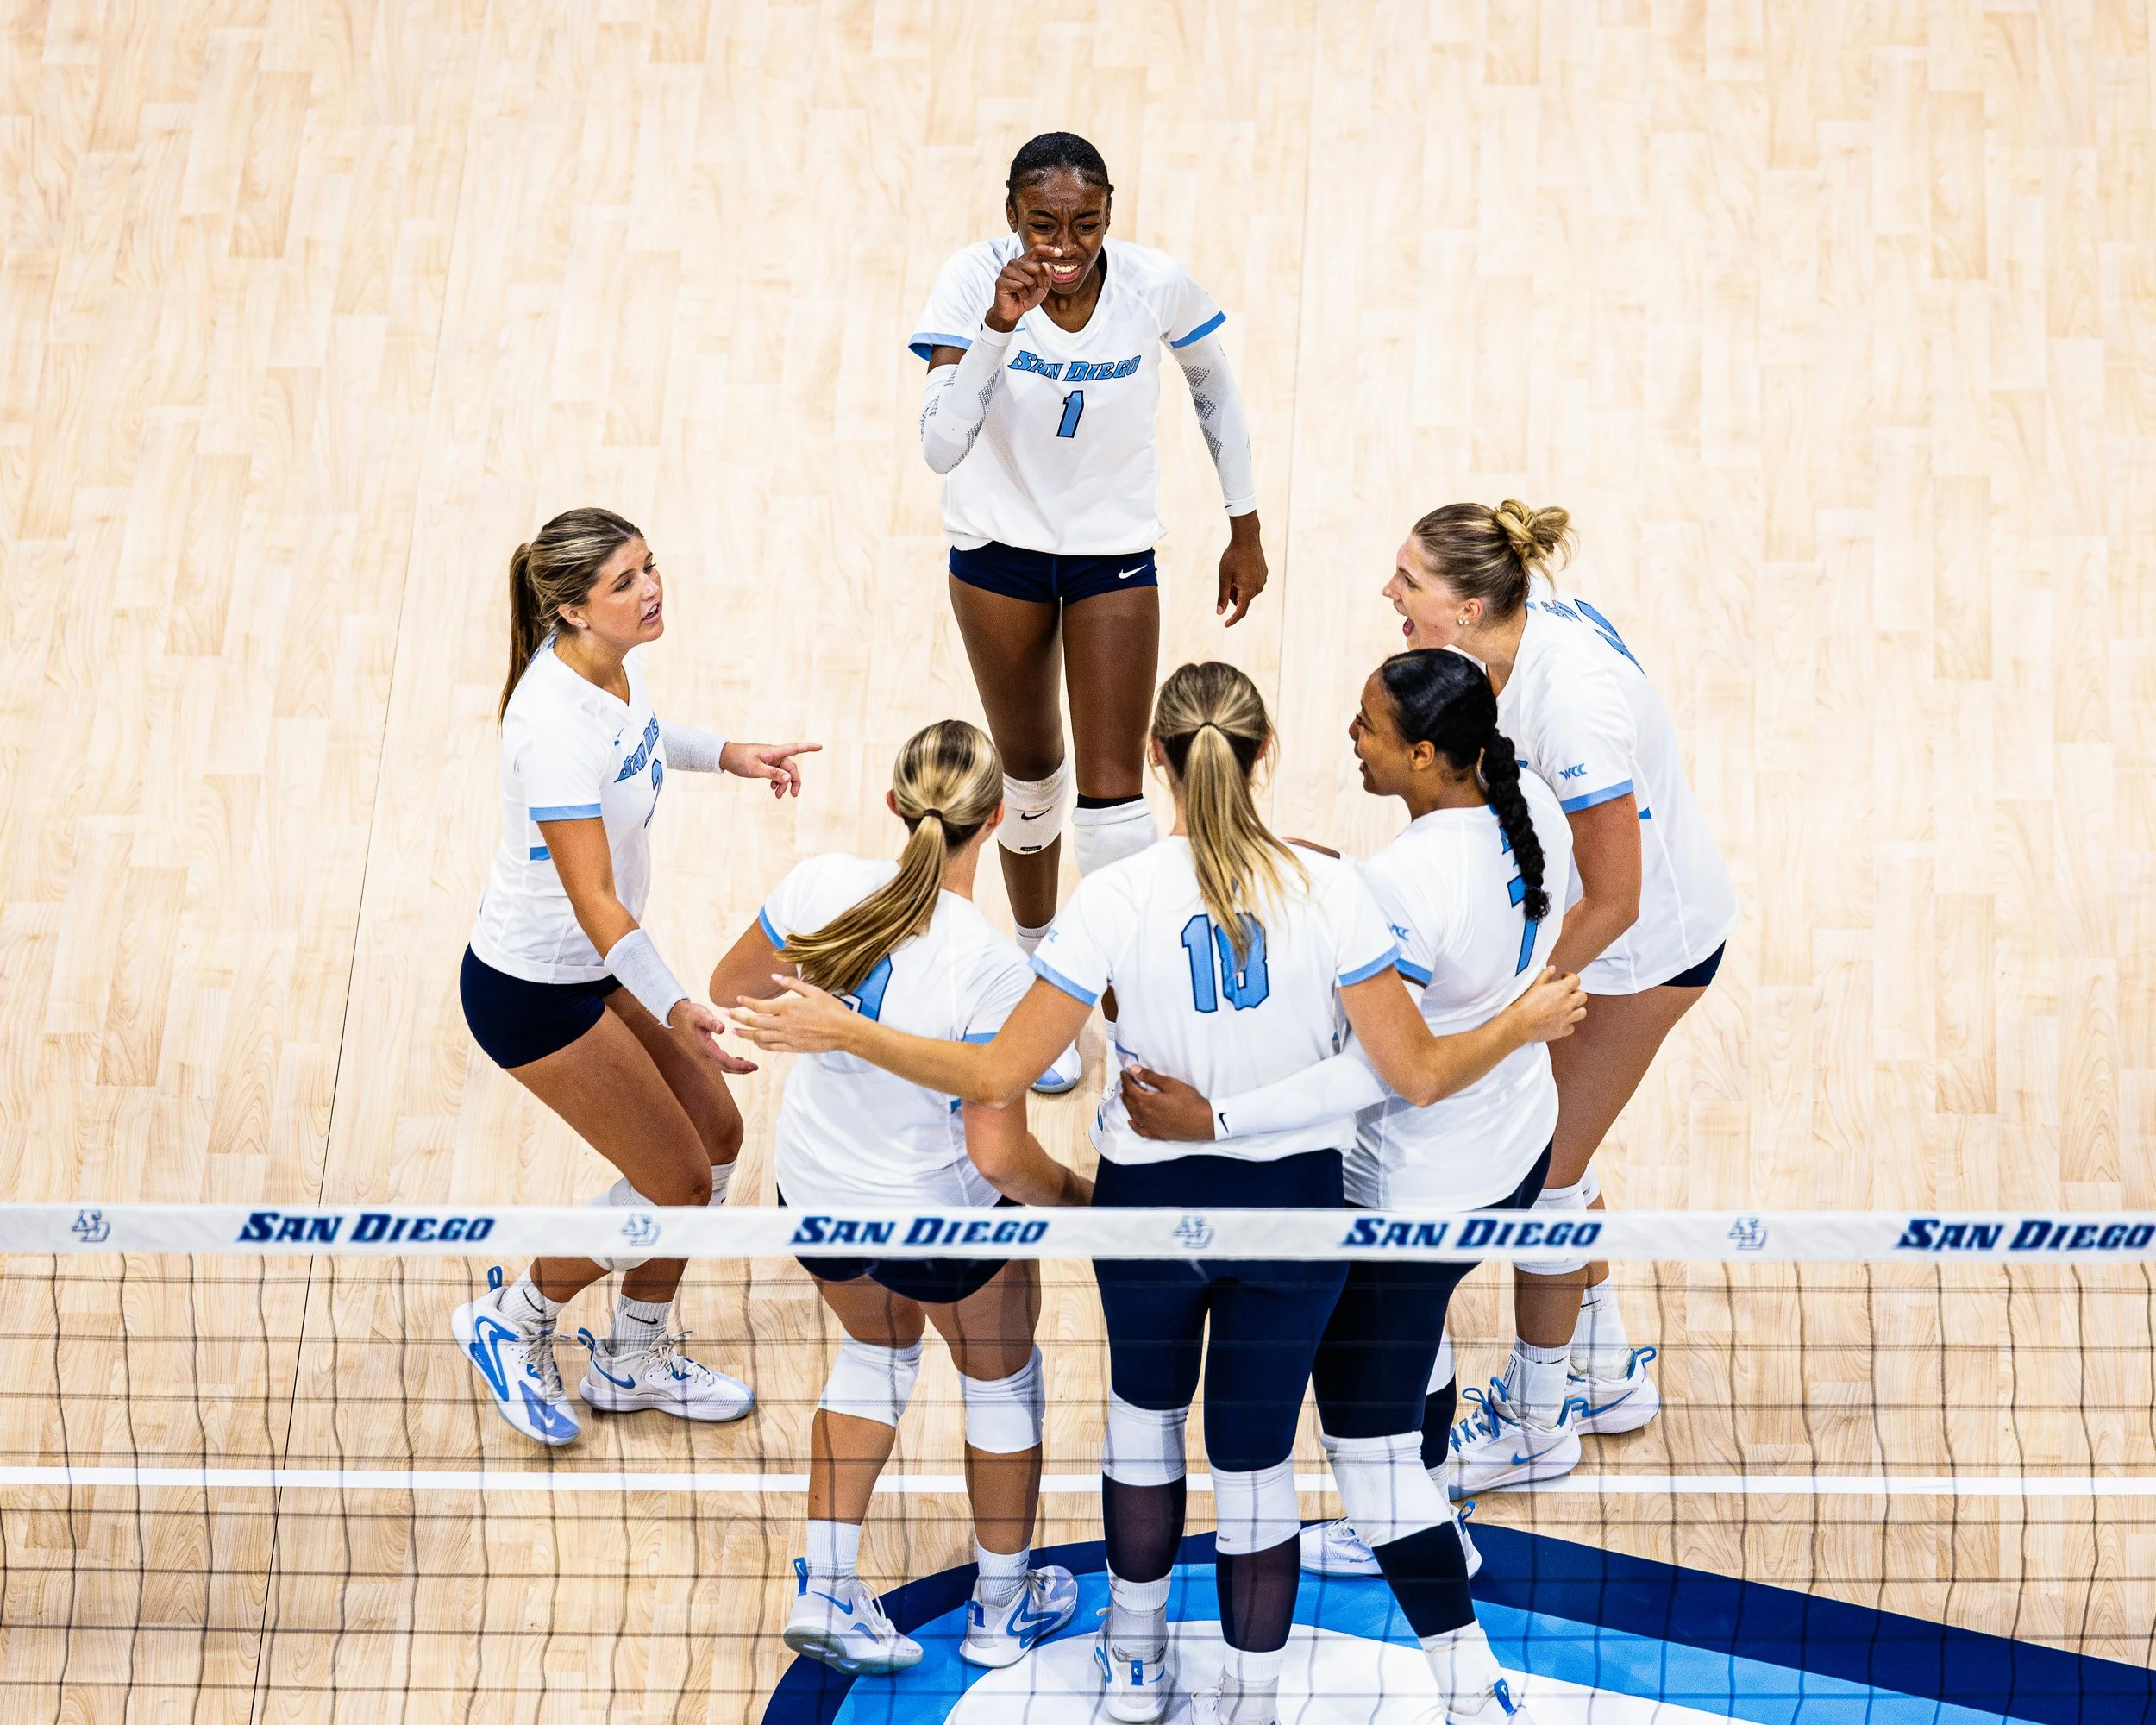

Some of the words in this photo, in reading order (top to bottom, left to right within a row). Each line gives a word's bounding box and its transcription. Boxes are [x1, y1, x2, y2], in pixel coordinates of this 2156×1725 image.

[1007, 349, 1063, 380] SAN
[1062, 354, 1142, 382] DIEGO
[1056, 390, 1085, 439] 1
[1558, 762, 1589, 781] WCC
[236, 1211, 343, 1244] SAN
[349, 1211, 497, 1244] DIEGO
[790, 1214, 896, 1246] SAN
[902, 1214, 1050, 1246] DIEGO
[1341, 1216, 1450, 1249] SAN
[1454, 1216, 1603, 1249] DIEGO
[1896, 1218, 2005, 1252] SAN
[2008, 1218, 2156, 1252] DIEGO
